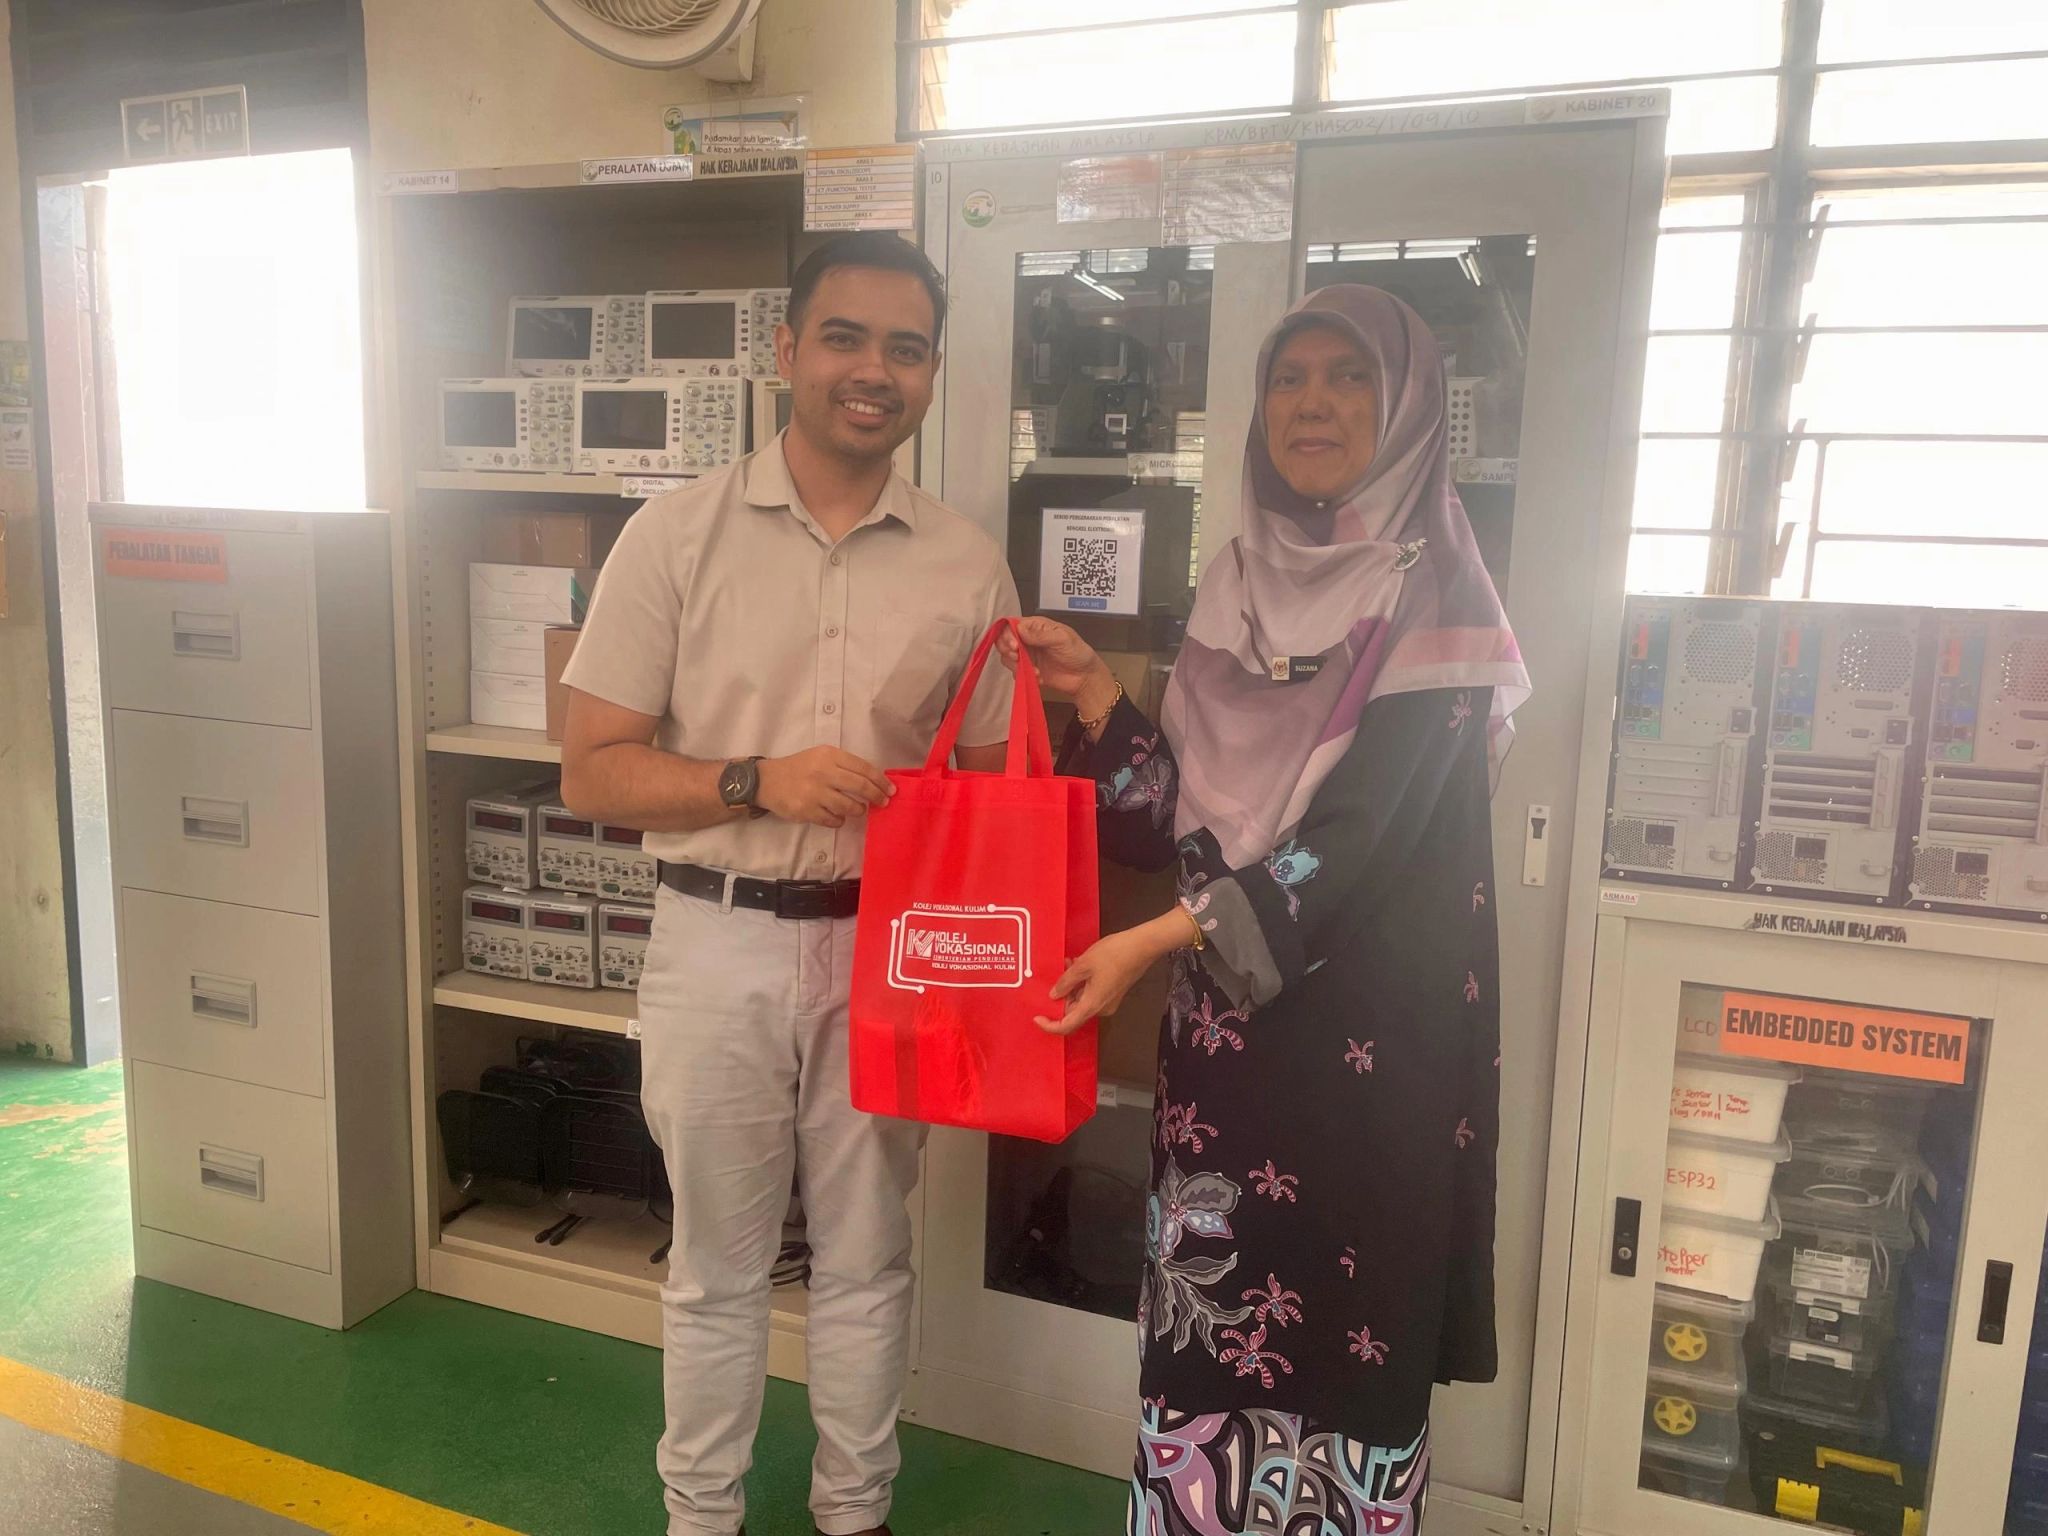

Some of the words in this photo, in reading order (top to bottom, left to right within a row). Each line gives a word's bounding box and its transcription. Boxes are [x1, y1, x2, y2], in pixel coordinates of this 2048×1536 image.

[1566, 96, 1632, 113] KABINET
[1637, 95, 1656, 108] 20
[205, 112, 237, 134] EXIT
[941, 143, 974, 157] HAK
[1071, 131, 1155, 151] MALAYSIA
[598, 163, 657, 176] PERALATAN
[700, 160, 716, 175] HAK
[718, 158, 758, 174] KERAJAAN
[760, 155, 799, 171] MALAYSIA
[399, 176, 436, 186] KABINET
[439, 175, 449, 185] 14
[931, 171, 942, 184] 10
[1481, 472, 1517, 482] SAMPL
[109, 541, 171, 562] PERALATAN
[175, 544, 220, 565] TANGAN
[933, 903, 963, 912] VOKASIONAL
[1752, 912, 1778, 931] HAK
[1781, 915, 1845, 937] KERAJAAN
[1848, 919, 1907, 943] MALAYSIA
[935, 931, 967, 944] KOLEJ
[934, 942, 1015, 955] VOKASIONAL
[1683, 1017, 1718, 1037] LCD
[1726, 1008, 1855, 1049] EMBEDDED
[1862, 1024, 1962, 1062] SYSTEM
[1666, 1168, 1716, 1190] ESP32
